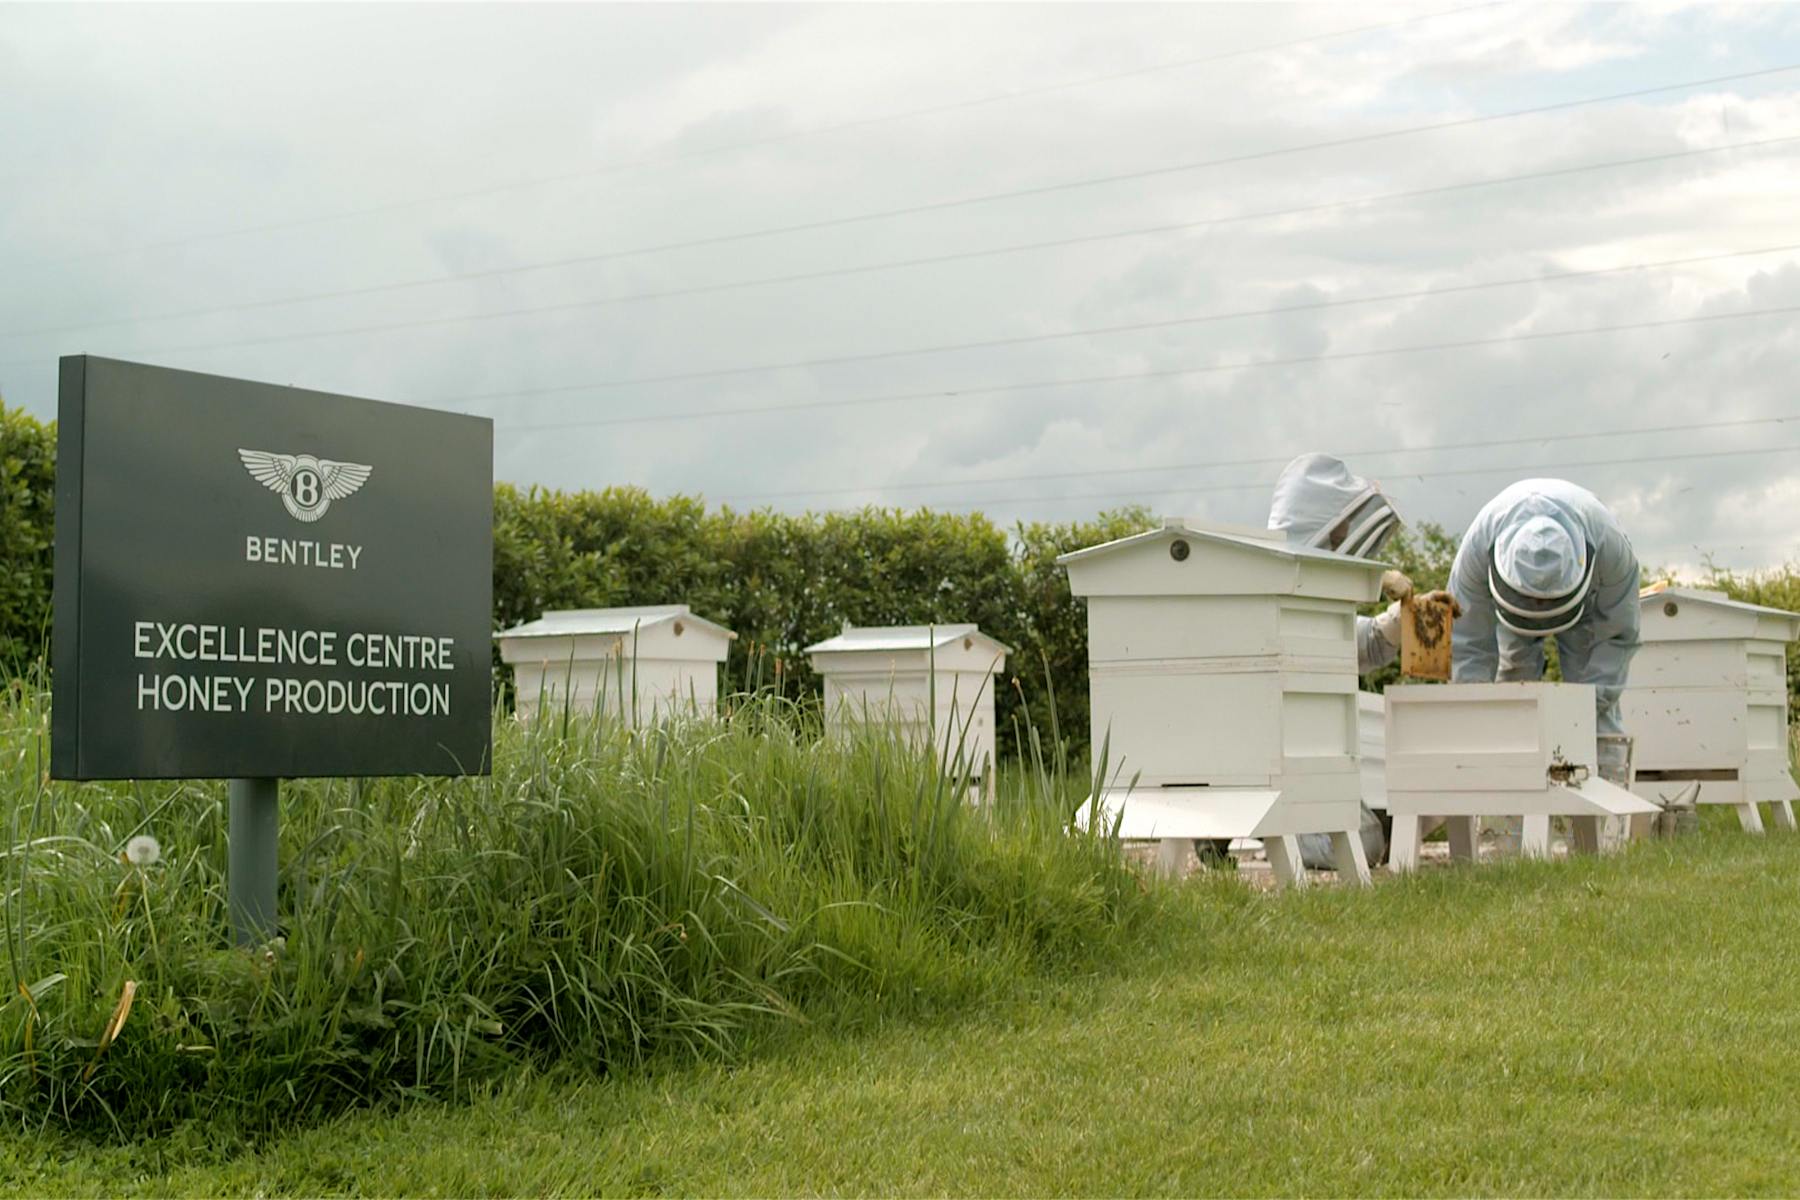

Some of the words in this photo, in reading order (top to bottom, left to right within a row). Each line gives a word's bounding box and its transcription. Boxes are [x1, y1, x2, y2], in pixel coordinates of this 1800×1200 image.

[296, 471, 318, 506] B
[246, 536, 362, 569] BENTLEY
[134, 621, 337, 666] EXCELLENCE
[347, 633, 454, 670] CENTRE
[138, 674, 255, 712] HONEY
[266, 679, 450, 716] PRODUCTION
